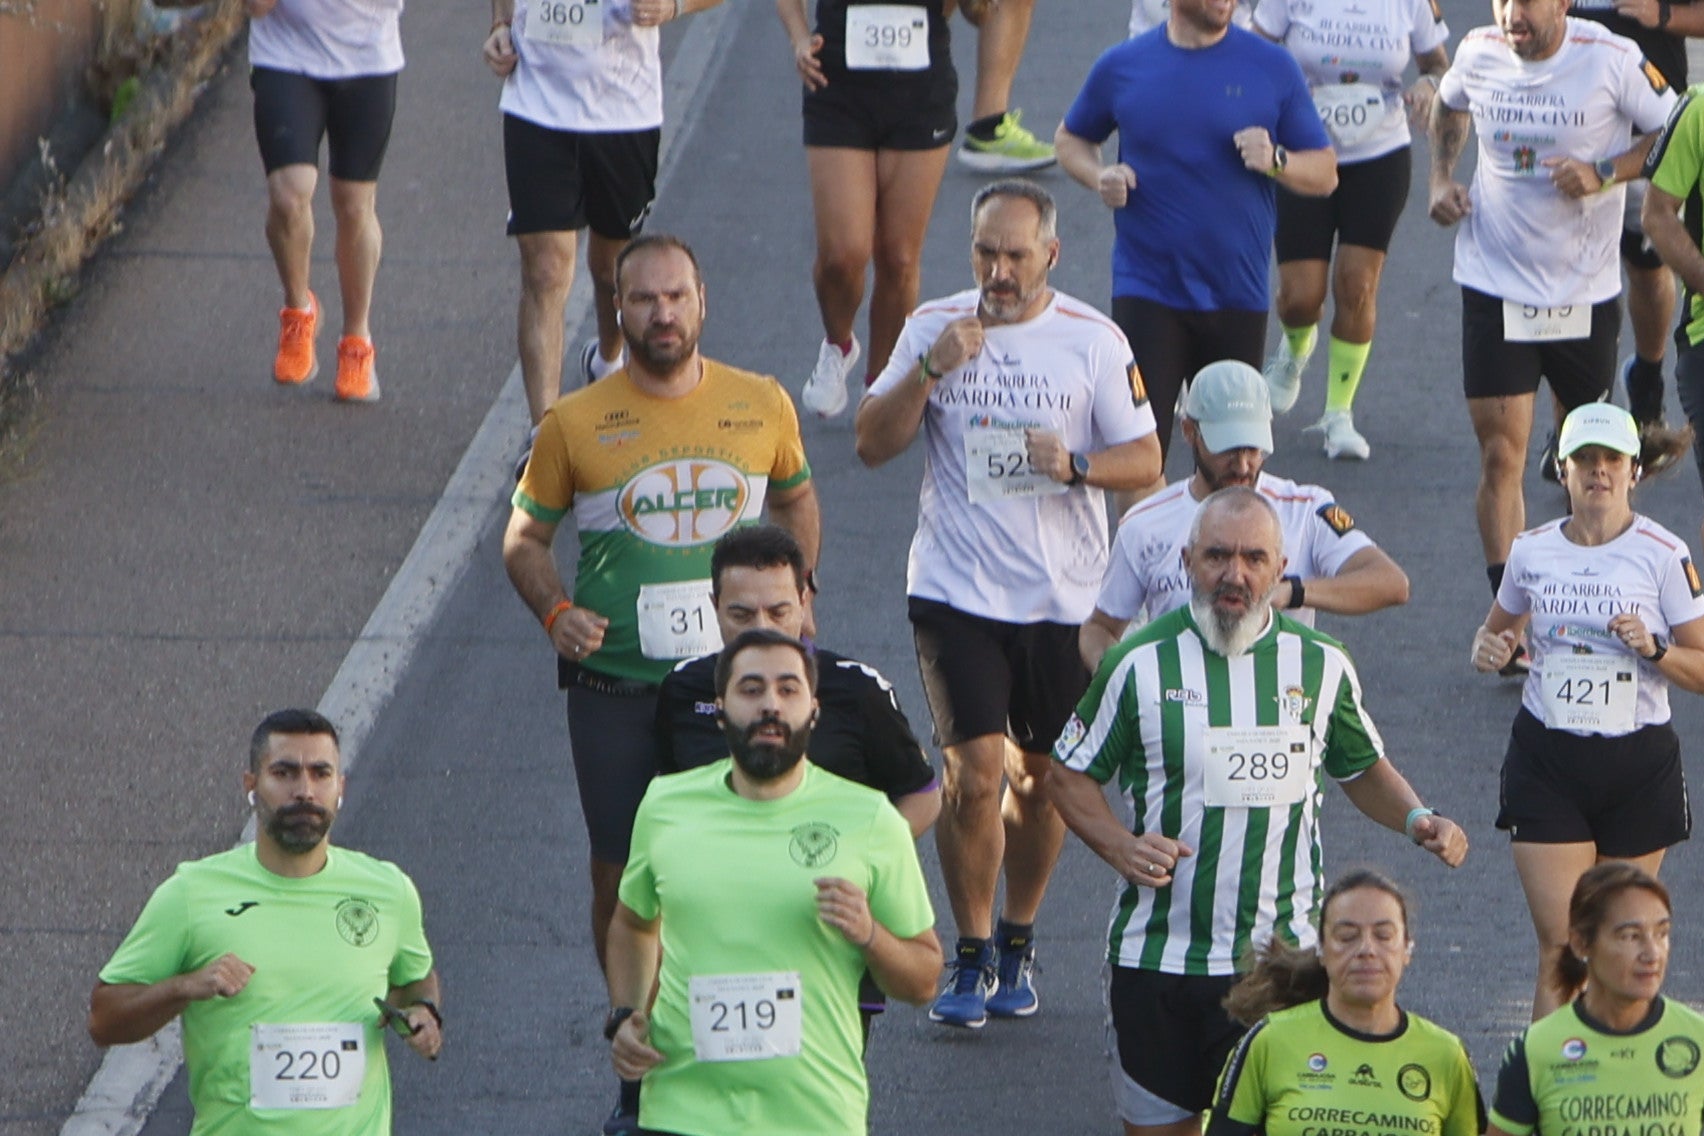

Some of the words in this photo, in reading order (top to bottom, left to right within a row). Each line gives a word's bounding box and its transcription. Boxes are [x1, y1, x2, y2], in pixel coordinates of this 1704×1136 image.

[539, 1, 584, 25] 360
[865, 25, 912, 48] 399
[1335, 20, 1388, 35] CARRERA
[1491, 89, 1505, 103] III
[1508, 93, 1566, 107] CARRERA
[1320, 104, 1367, 127] 260
[1542, 110, 1585, 127] CIVIL
[963, 371, 978, 384] III
[983, 374, 1048, 389] CARRERA
[1024, 392, 1071, 410] CIVIL
[988, 452, 1043, 478] 52
[632, 488, 738, 515] ALCER
[1544, 583, 1557, 596] III
[1562, 583, 1622, 597] CARRERA
[670, 606, 704, 635] 31
[1556, 678, 1609, 705] 421
[1227, 752, 1289, 780] 289
[710, 1000, 776, 1032] 219
[275, 1050, 341, 1080] 220
[1560, 1092, 1688, 1122] CORRECAMINOS
[1288, 1107, 1437, 1134] CORRECAMINOS
